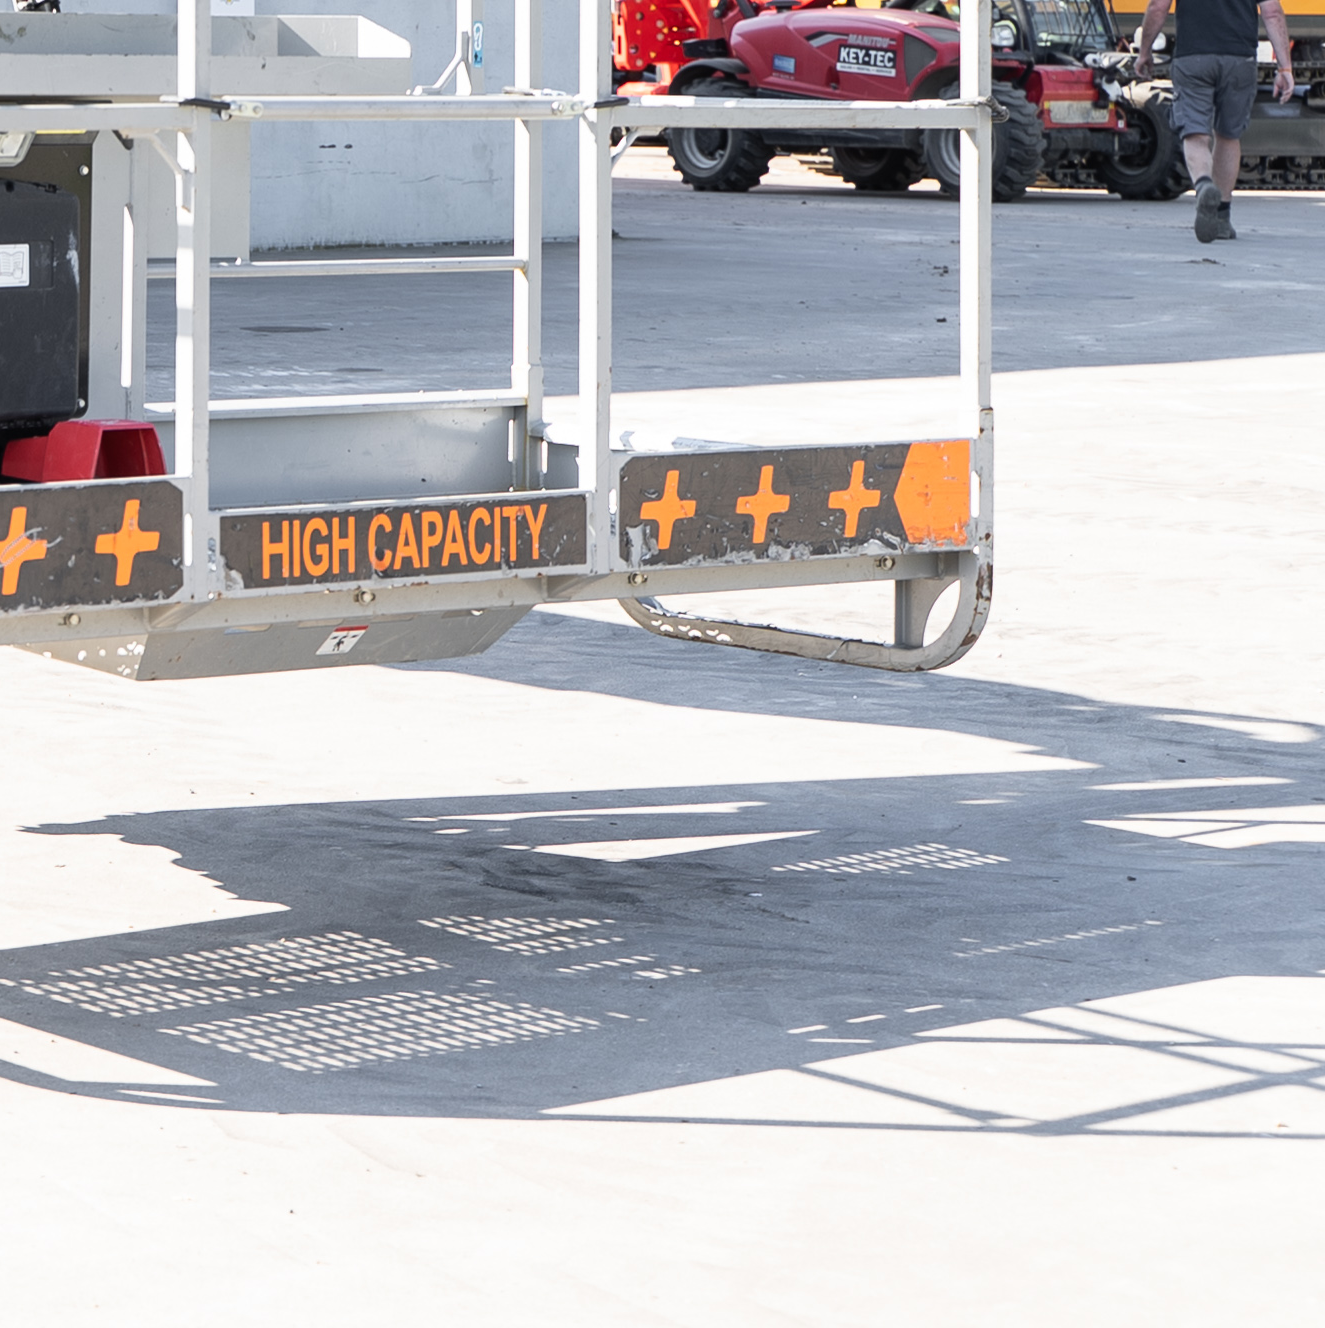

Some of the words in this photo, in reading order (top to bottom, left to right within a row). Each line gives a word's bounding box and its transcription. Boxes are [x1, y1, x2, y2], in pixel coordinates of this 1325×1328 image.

[847, 34, 890, 48] MANITOU
[839, 47, 894, 68] KEY-TEC
[261, 516, 355, 580] HIGH
[367, 504, 548, 571] CAPACITY
